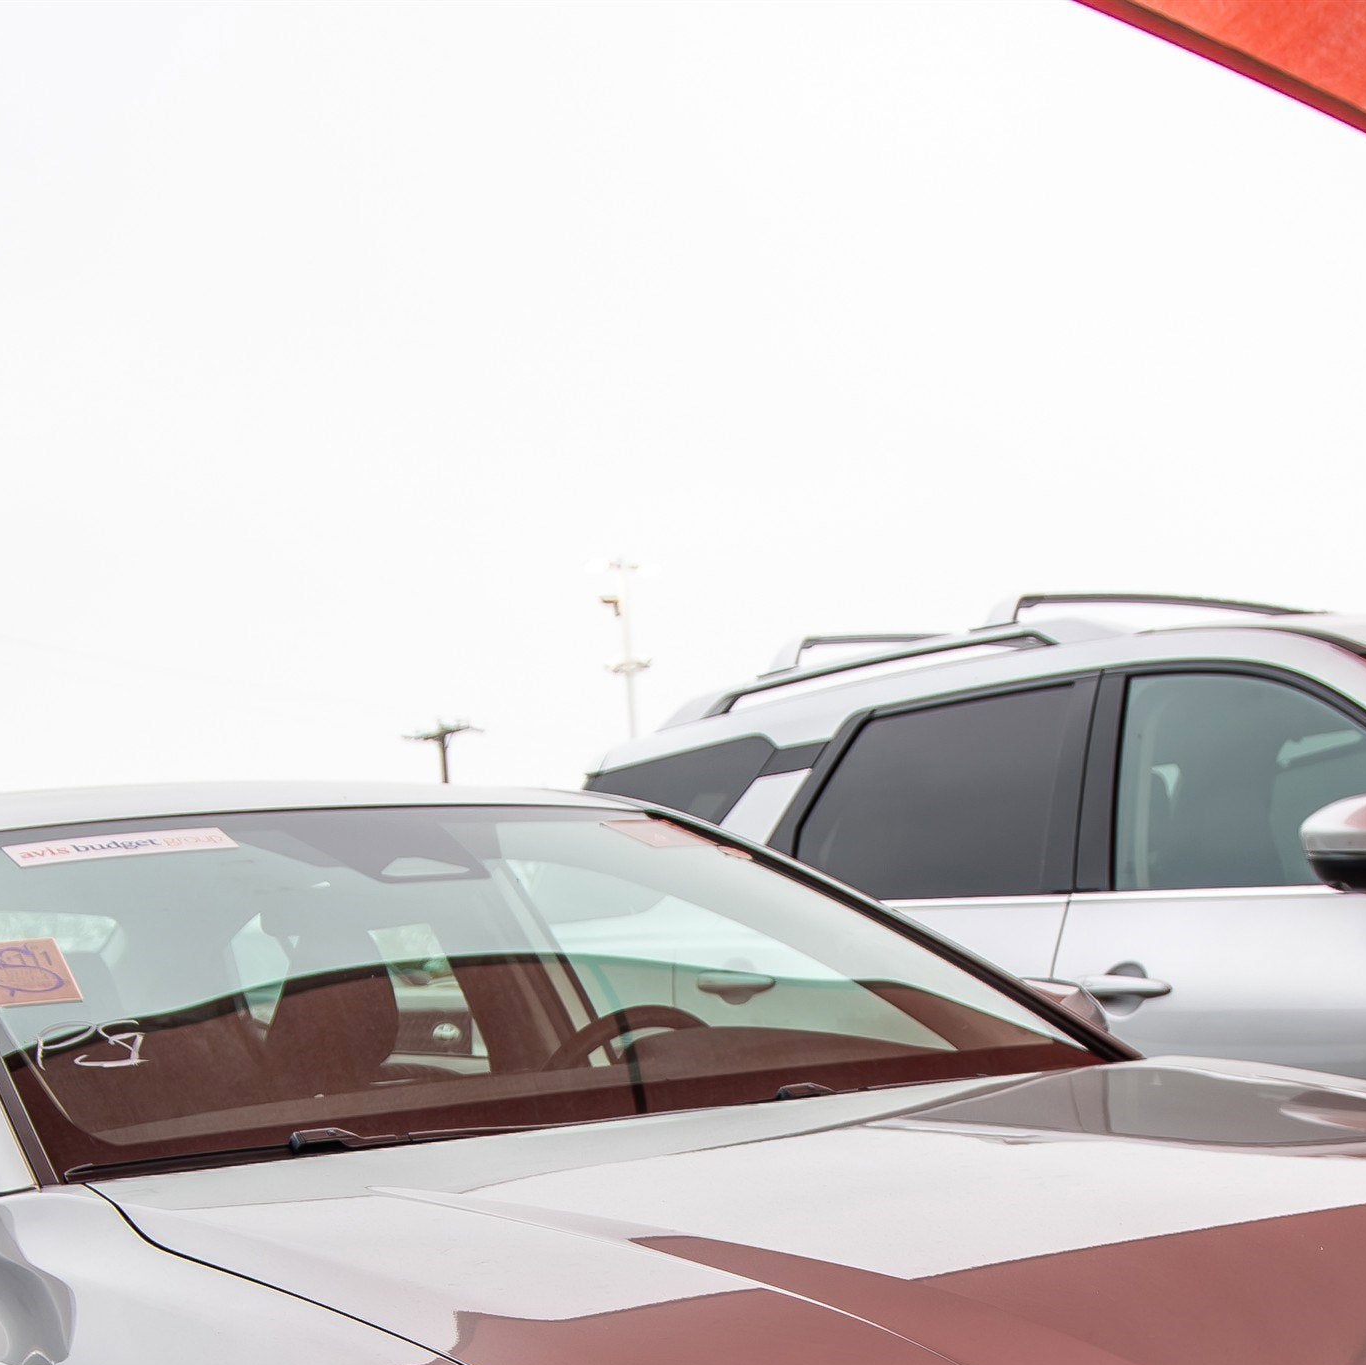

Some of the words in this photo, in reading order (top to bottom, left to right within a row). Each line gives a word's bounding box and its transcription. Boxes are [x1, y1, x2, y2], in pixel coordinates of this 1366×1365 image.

[20, 845, 70, 860] avis
[70, 836, 162, 853] budget
[162, 833, 224, 848] group
